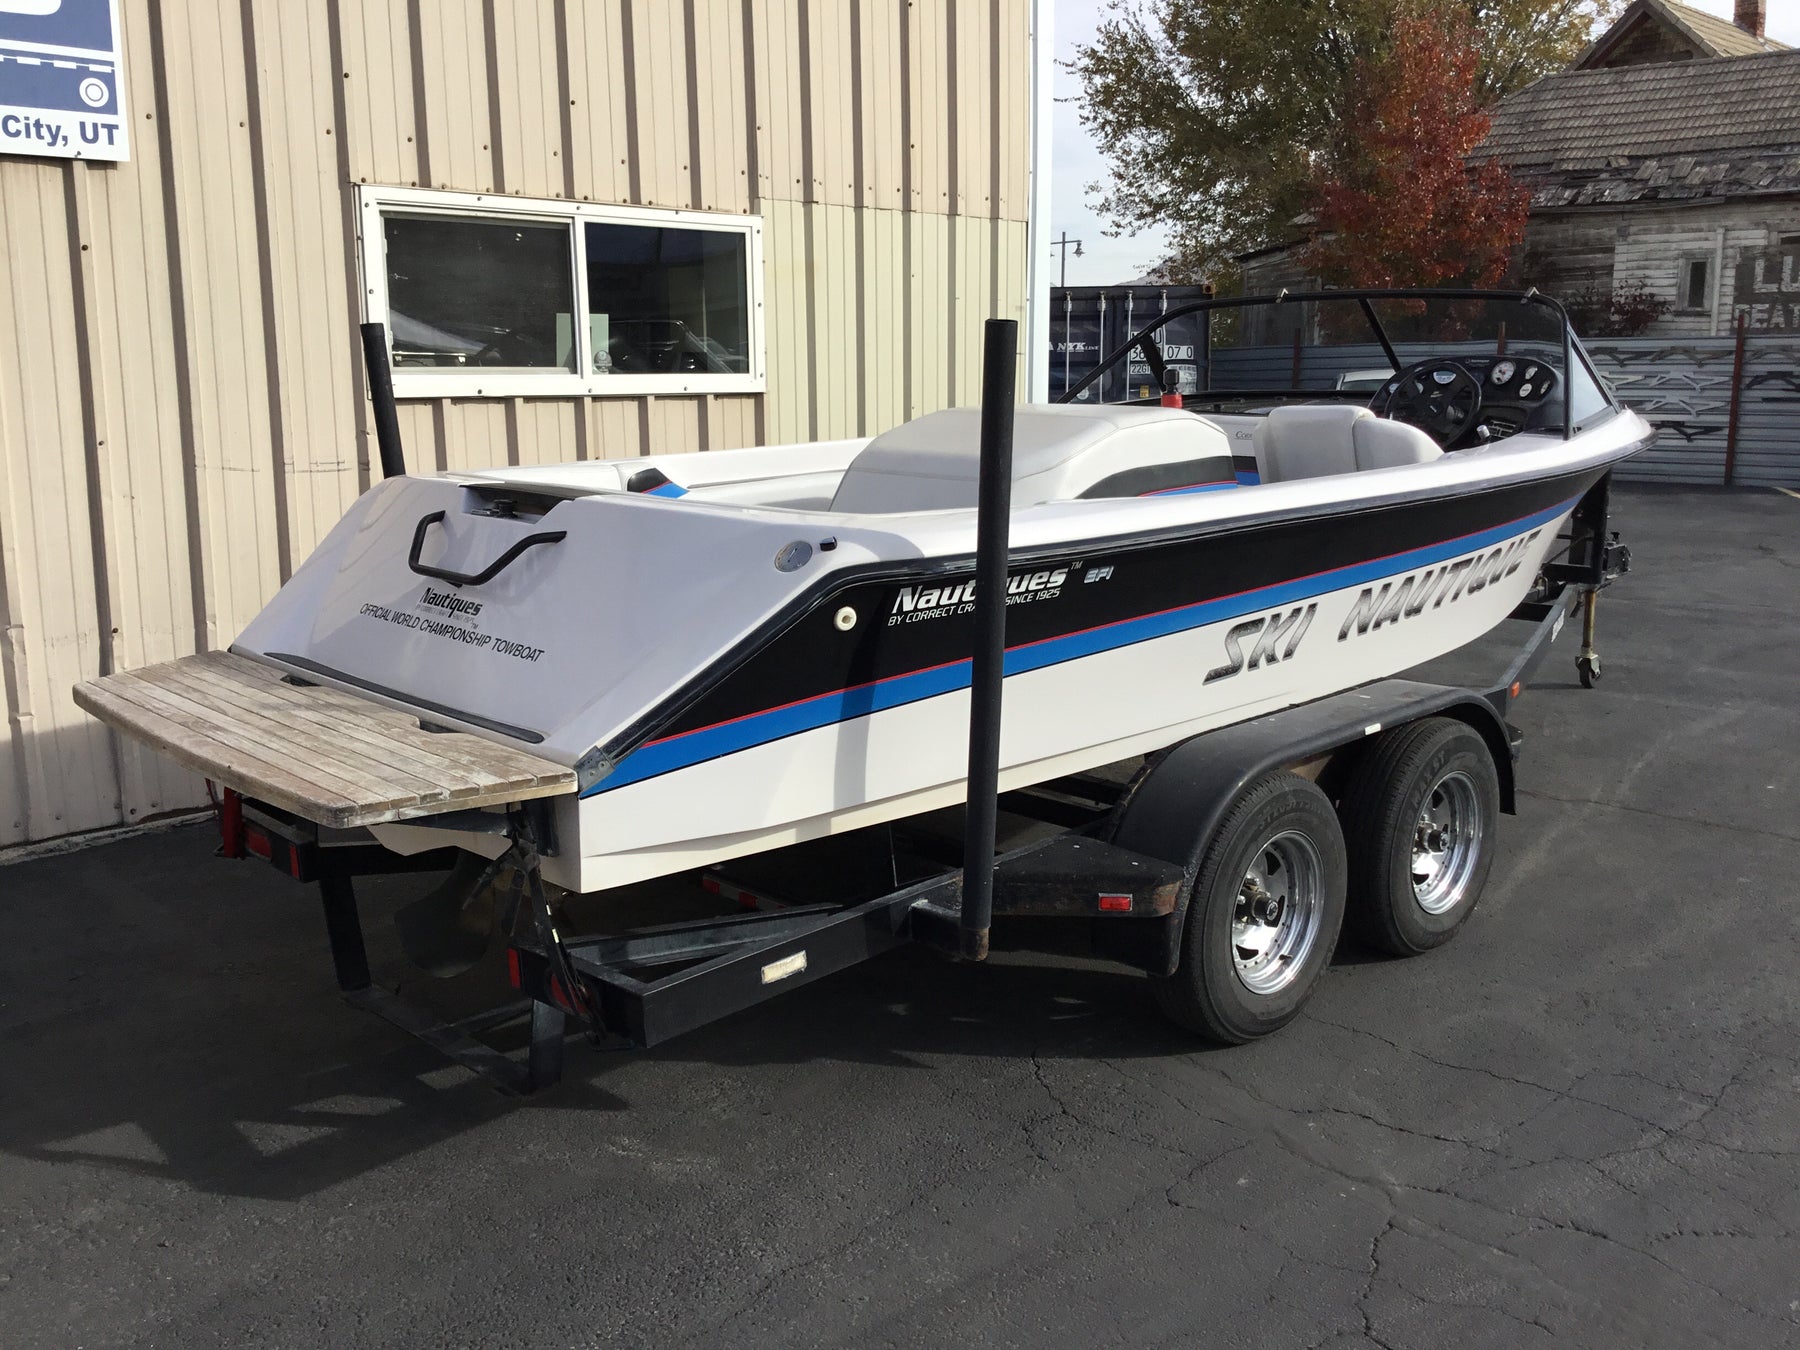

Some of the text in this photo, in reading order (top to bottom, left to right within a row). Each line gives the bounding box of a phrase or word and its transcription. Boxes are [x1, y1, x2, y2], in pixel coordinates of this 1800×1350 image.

[2, 115, 119, 147] City, UT
[420, 587, 483, 618] Nautiques
[888, 615, 905, 627] BY
[905, 606, 957, 623] CORRECT
[1005, 592, 1035, 606] SINCE
[1035, 588, 1061, 601] 1925
[891, 568, 1069, 614] Nautues
[360, 603, 390, 622] OFFICIAL
[390, 609, 420, 629] WORLD
[420, 619, 492, 648] CHAMPIONSHIP
[491, 638, 545, 663] TOWBOAT
[1202, 602, 1318, 685] SKI
